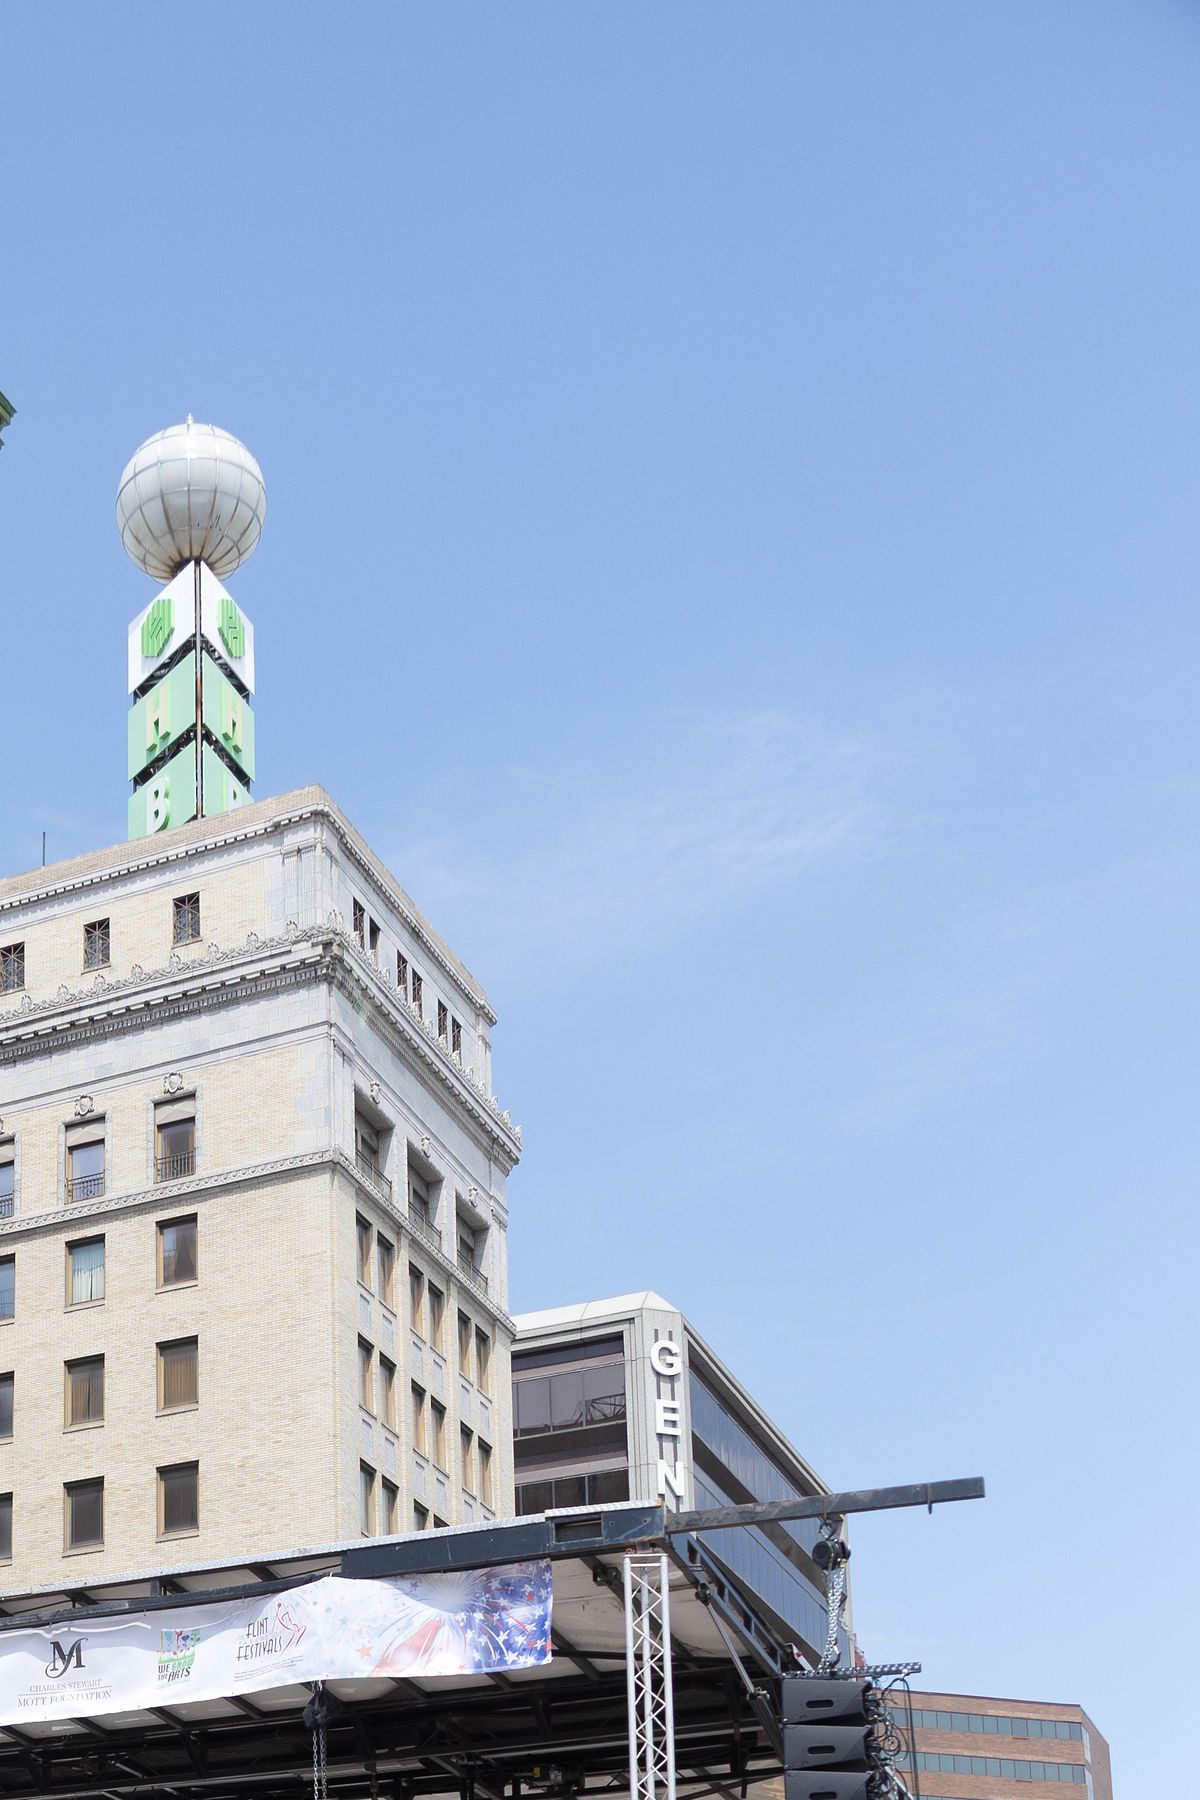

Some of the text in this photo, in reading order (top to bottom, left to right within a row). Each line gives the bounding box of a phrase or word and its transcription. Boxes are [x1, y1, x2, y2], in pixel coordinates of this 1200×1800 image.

[650, 1340, 685, 1497] GEN
[246, 1616, 269, 1638] FLINT
[236, 1636, 282, 1661] FESTIVALS
[158, 1664, 170, 1673] WE
[158, 1666, 191, 1682] THE ARTS
[29, 1679, 102, 1693] CHARLES STEWART
[17, 1696, 47, 1707] MOTT
